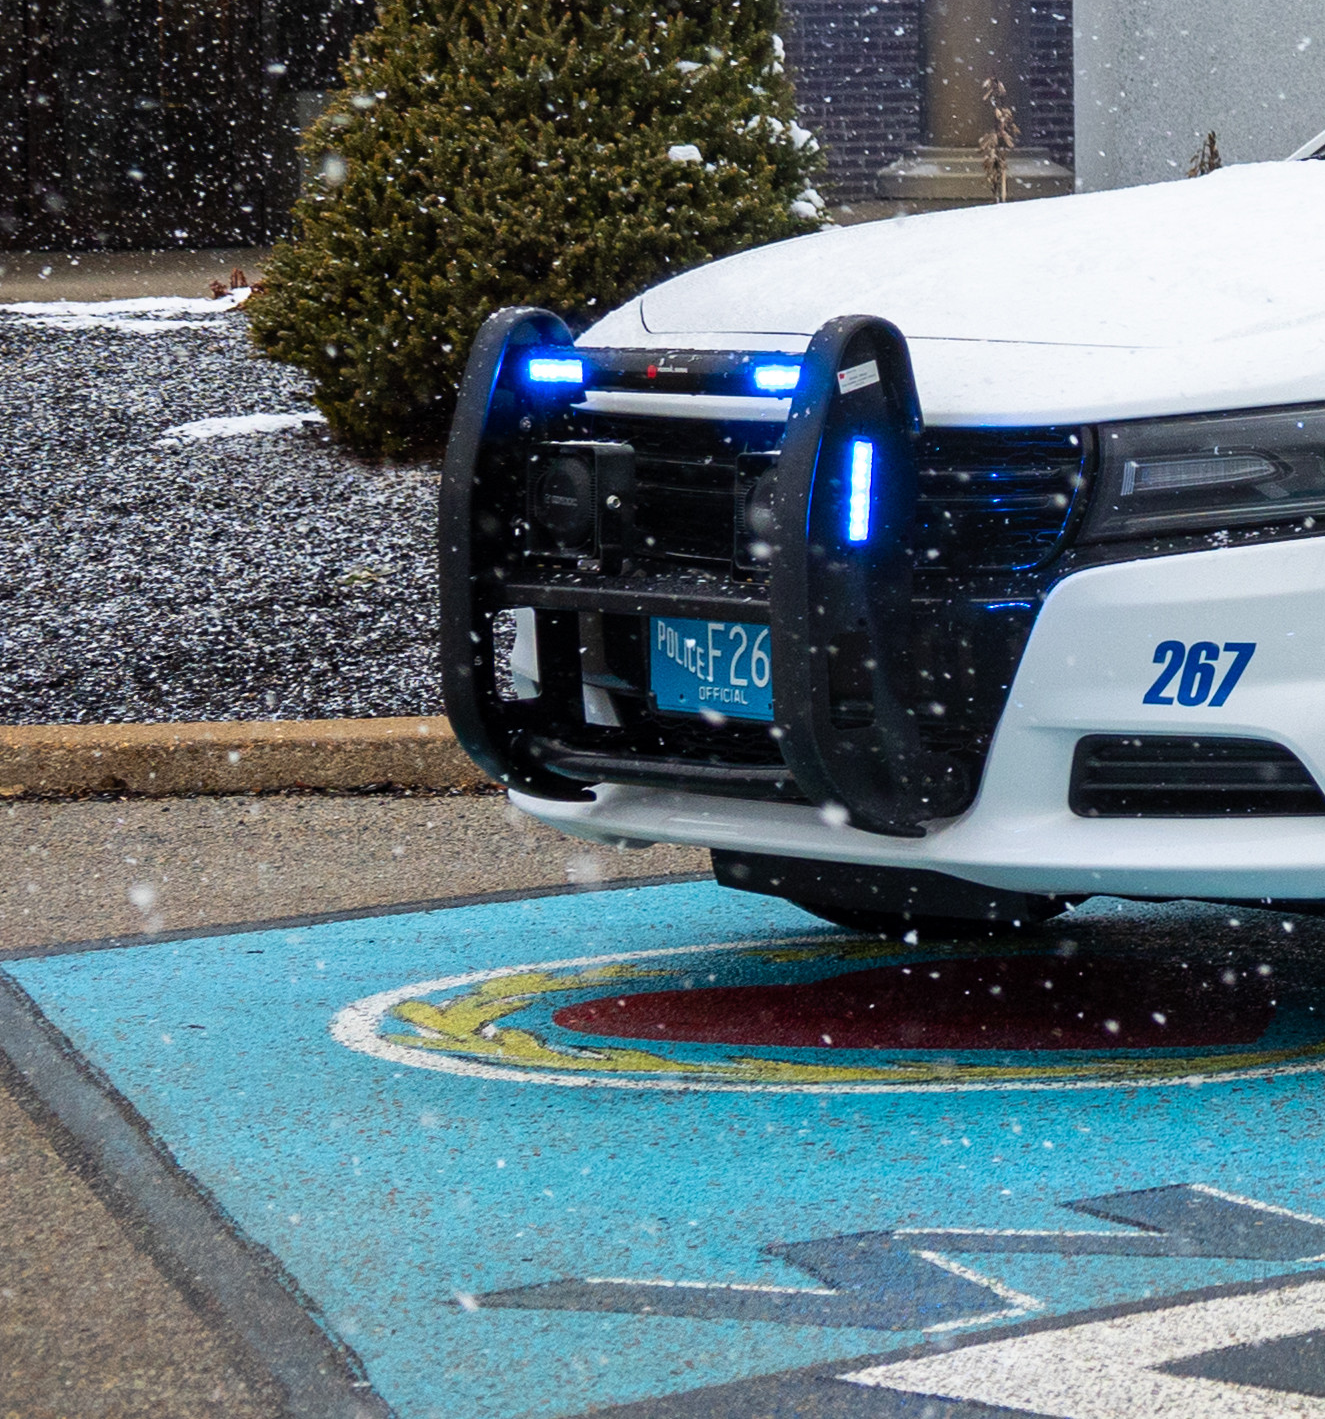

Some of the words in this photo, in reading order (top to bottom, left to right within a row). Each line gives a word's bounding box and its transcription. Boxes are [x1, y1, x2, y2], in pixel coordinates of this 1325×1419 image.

[657, 620, 705, 681] POLICE
[1142, 640, 1257, 708] 267
[698, 686, 749, 705] OFFICIAL
